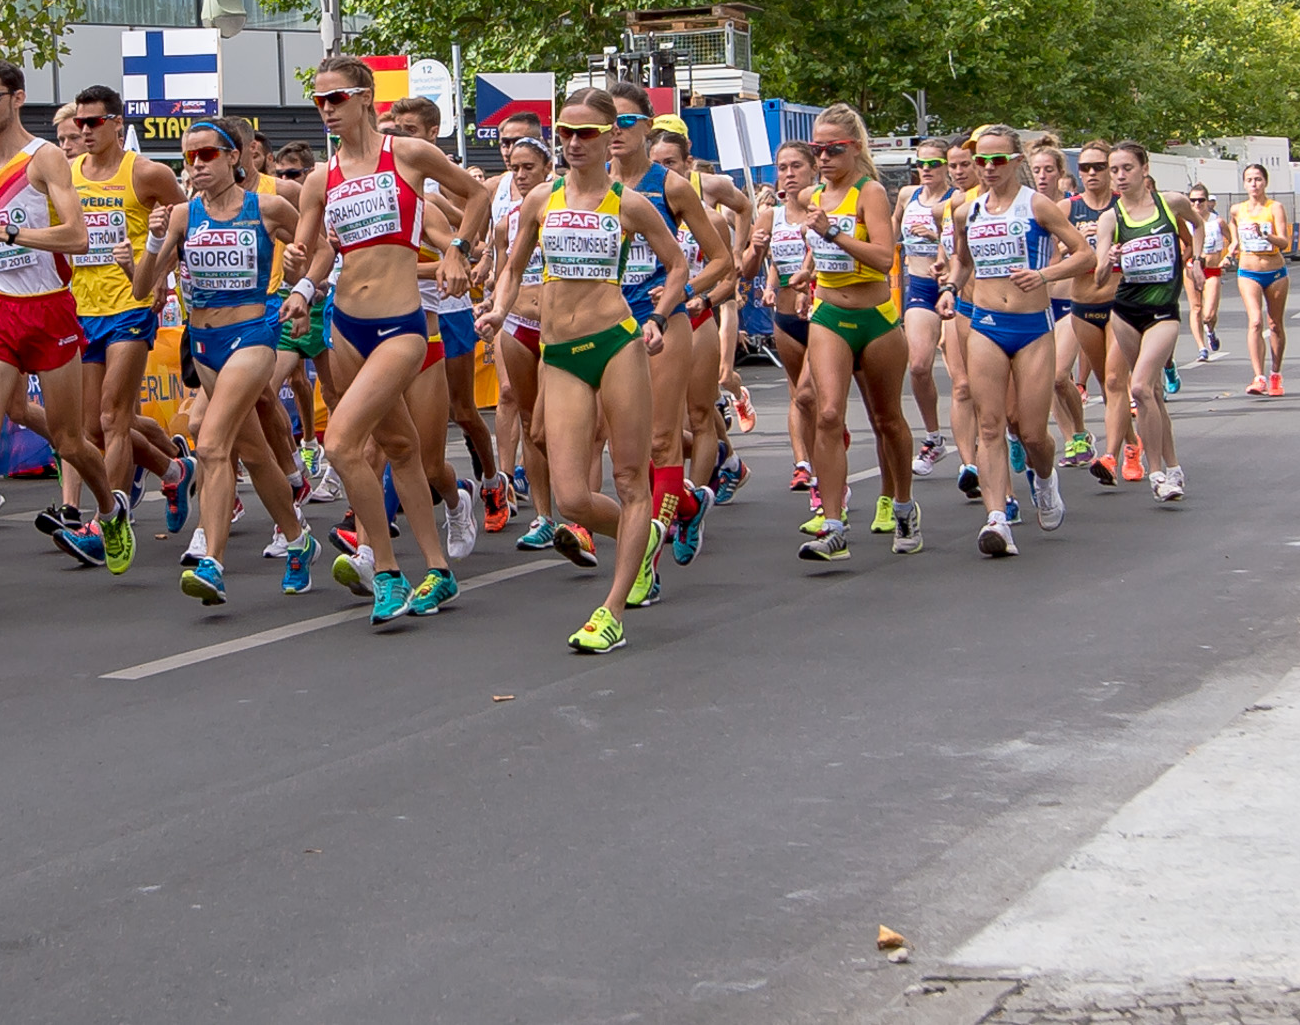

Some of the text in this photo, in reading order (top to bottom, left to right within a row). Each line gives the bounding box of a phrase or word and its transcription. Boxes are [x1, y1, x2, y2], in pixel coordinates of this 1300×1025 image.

[128, 101, 150, 115] FIN
[477, 127, 498, 139] CZE
[328, 177, 375, 200] SPAR
[547, 212, 599, 228] SPAR
[89, 229, 117, 245] STRÖM
[342, 221, 396, 244] BERLIN 2018
[969, 224, 1008, 239] SPAR
[1122, 238, 1161, 253] SPAR
[9, 255, 32, 268] 2018
[75, 255, 101, 265] BERLIN
[189, 249, 244, 267] GIORGI
[827, 260, 849, 271] 2018
[1124, 251, 1169, 269] SMERDOVA
[552, 264, 612, 278] BERLIN 2018
[195, 278, 252, 289] BERLIN 2018
[140, 374, 185, 404] ERLIN
